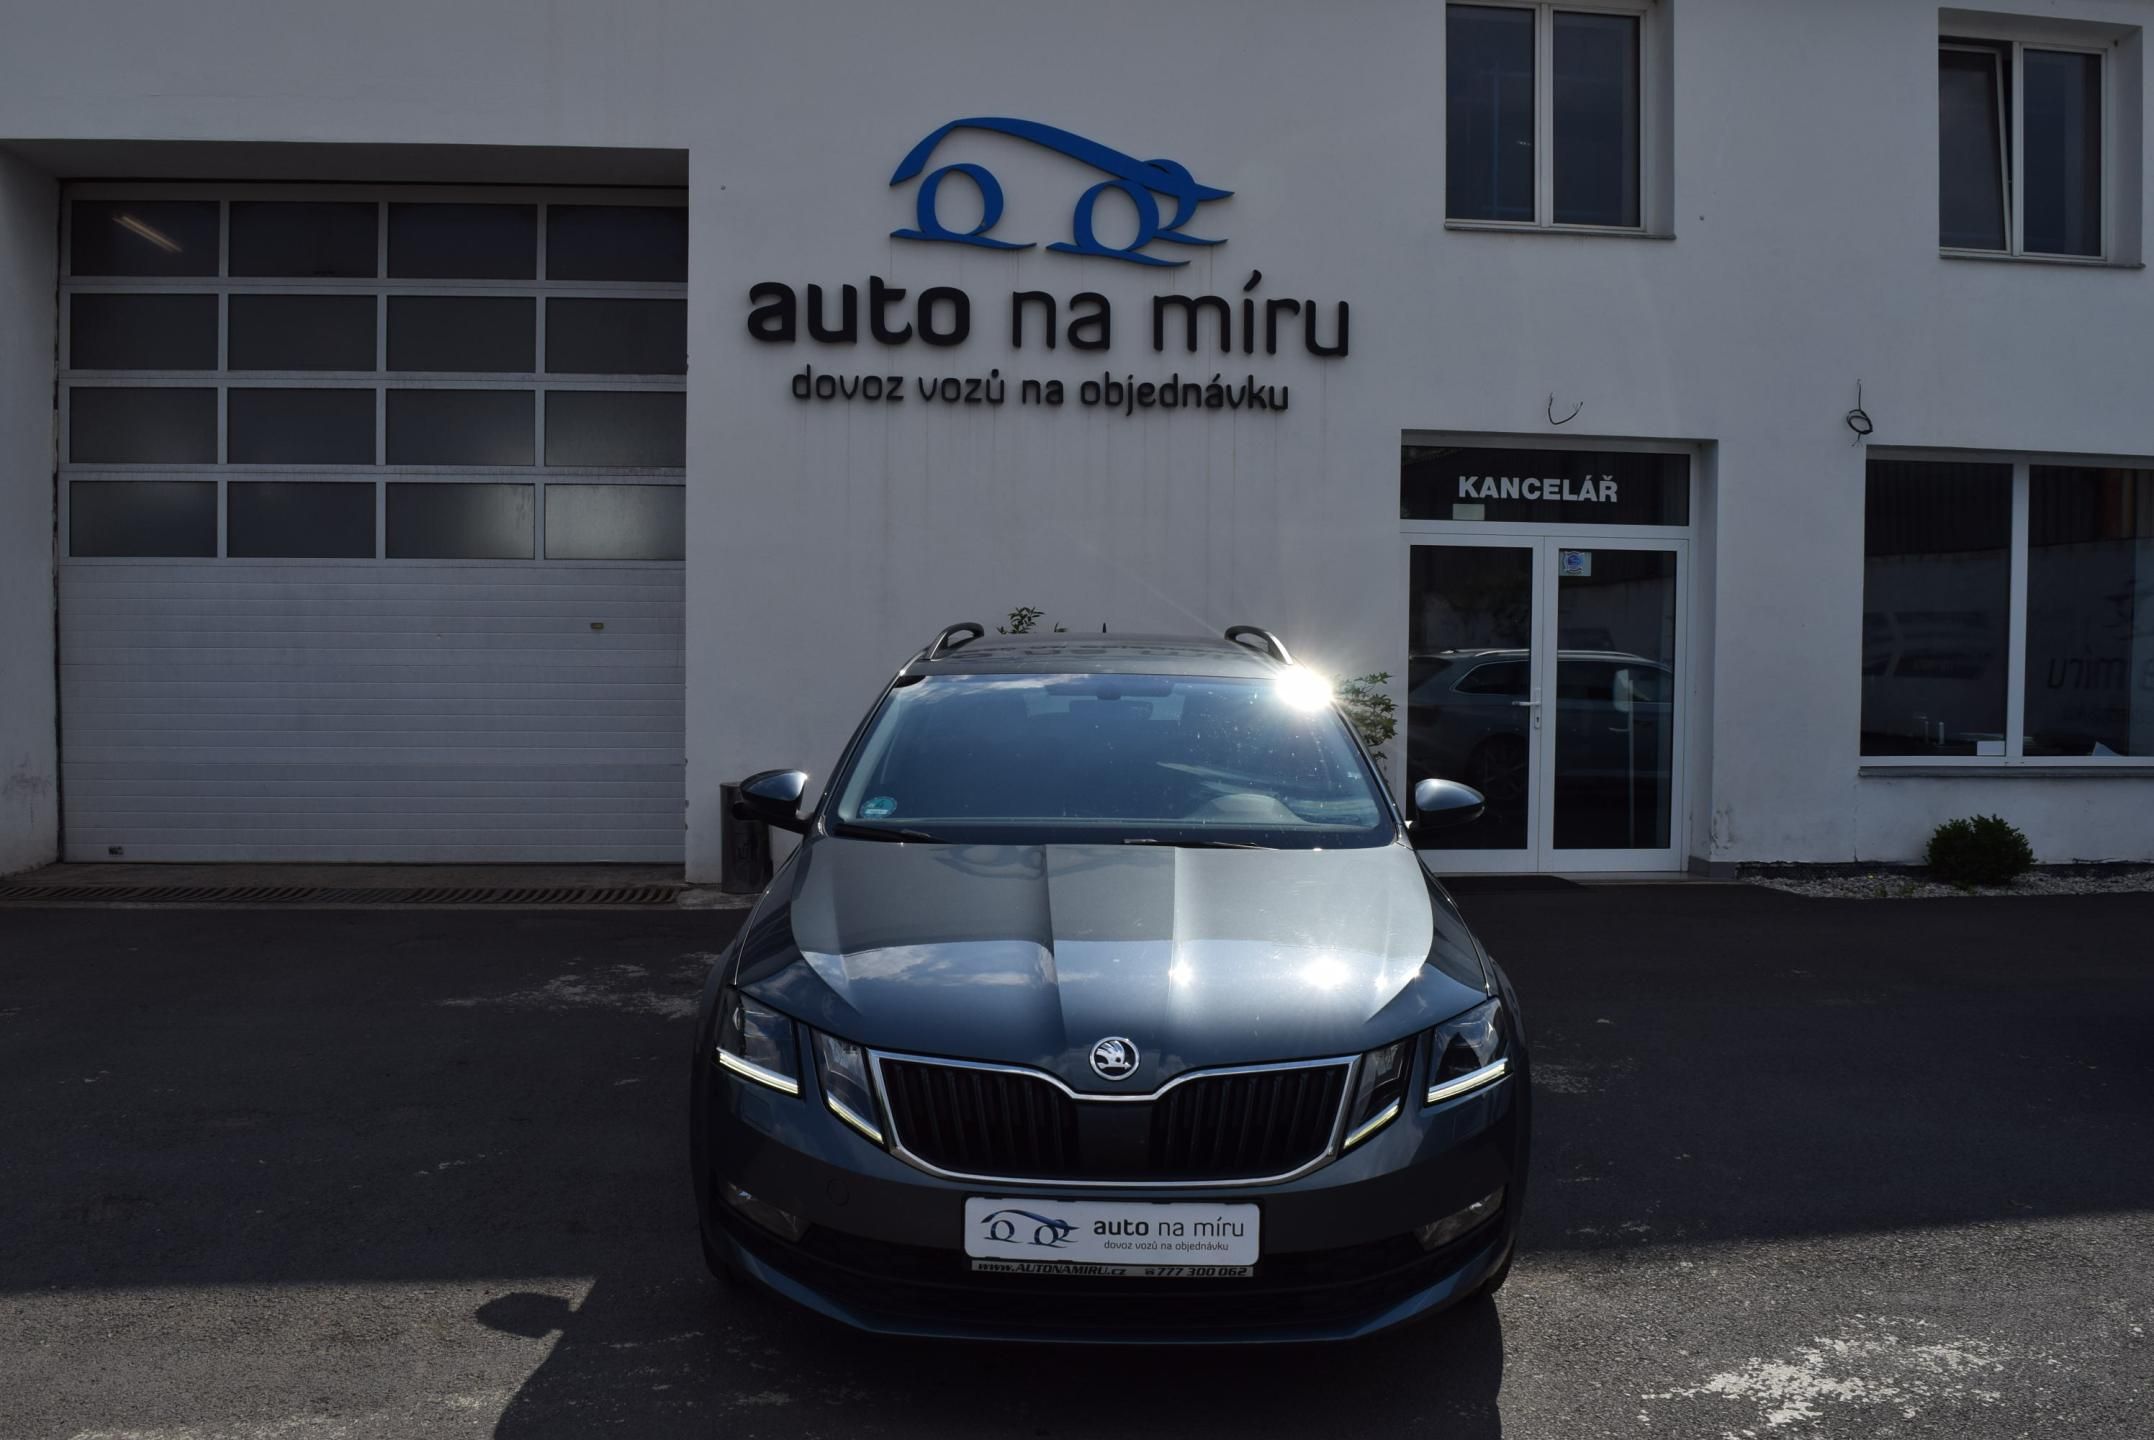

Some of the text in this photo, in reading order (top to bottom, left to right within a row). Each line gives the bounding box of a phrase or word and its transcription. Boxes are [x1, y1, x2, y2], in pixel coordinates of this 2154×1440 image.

[748, 268, 1350, 359] auto na míru
[791, 364, 1289, 417] dovoz vozů na objednávku
[1457, 474, 1619, 503] KANCELÁŘ
[1093, 1216, 1244, 1237] auto na míru
[1104, 1239, 1229, 1253] dovoz vozů na objednávku
[1157, 1267, 1184, 1277] 777
[1186, 1267, 1216, 1277] 300
[1219, 1267, 1248, 1278] 062
